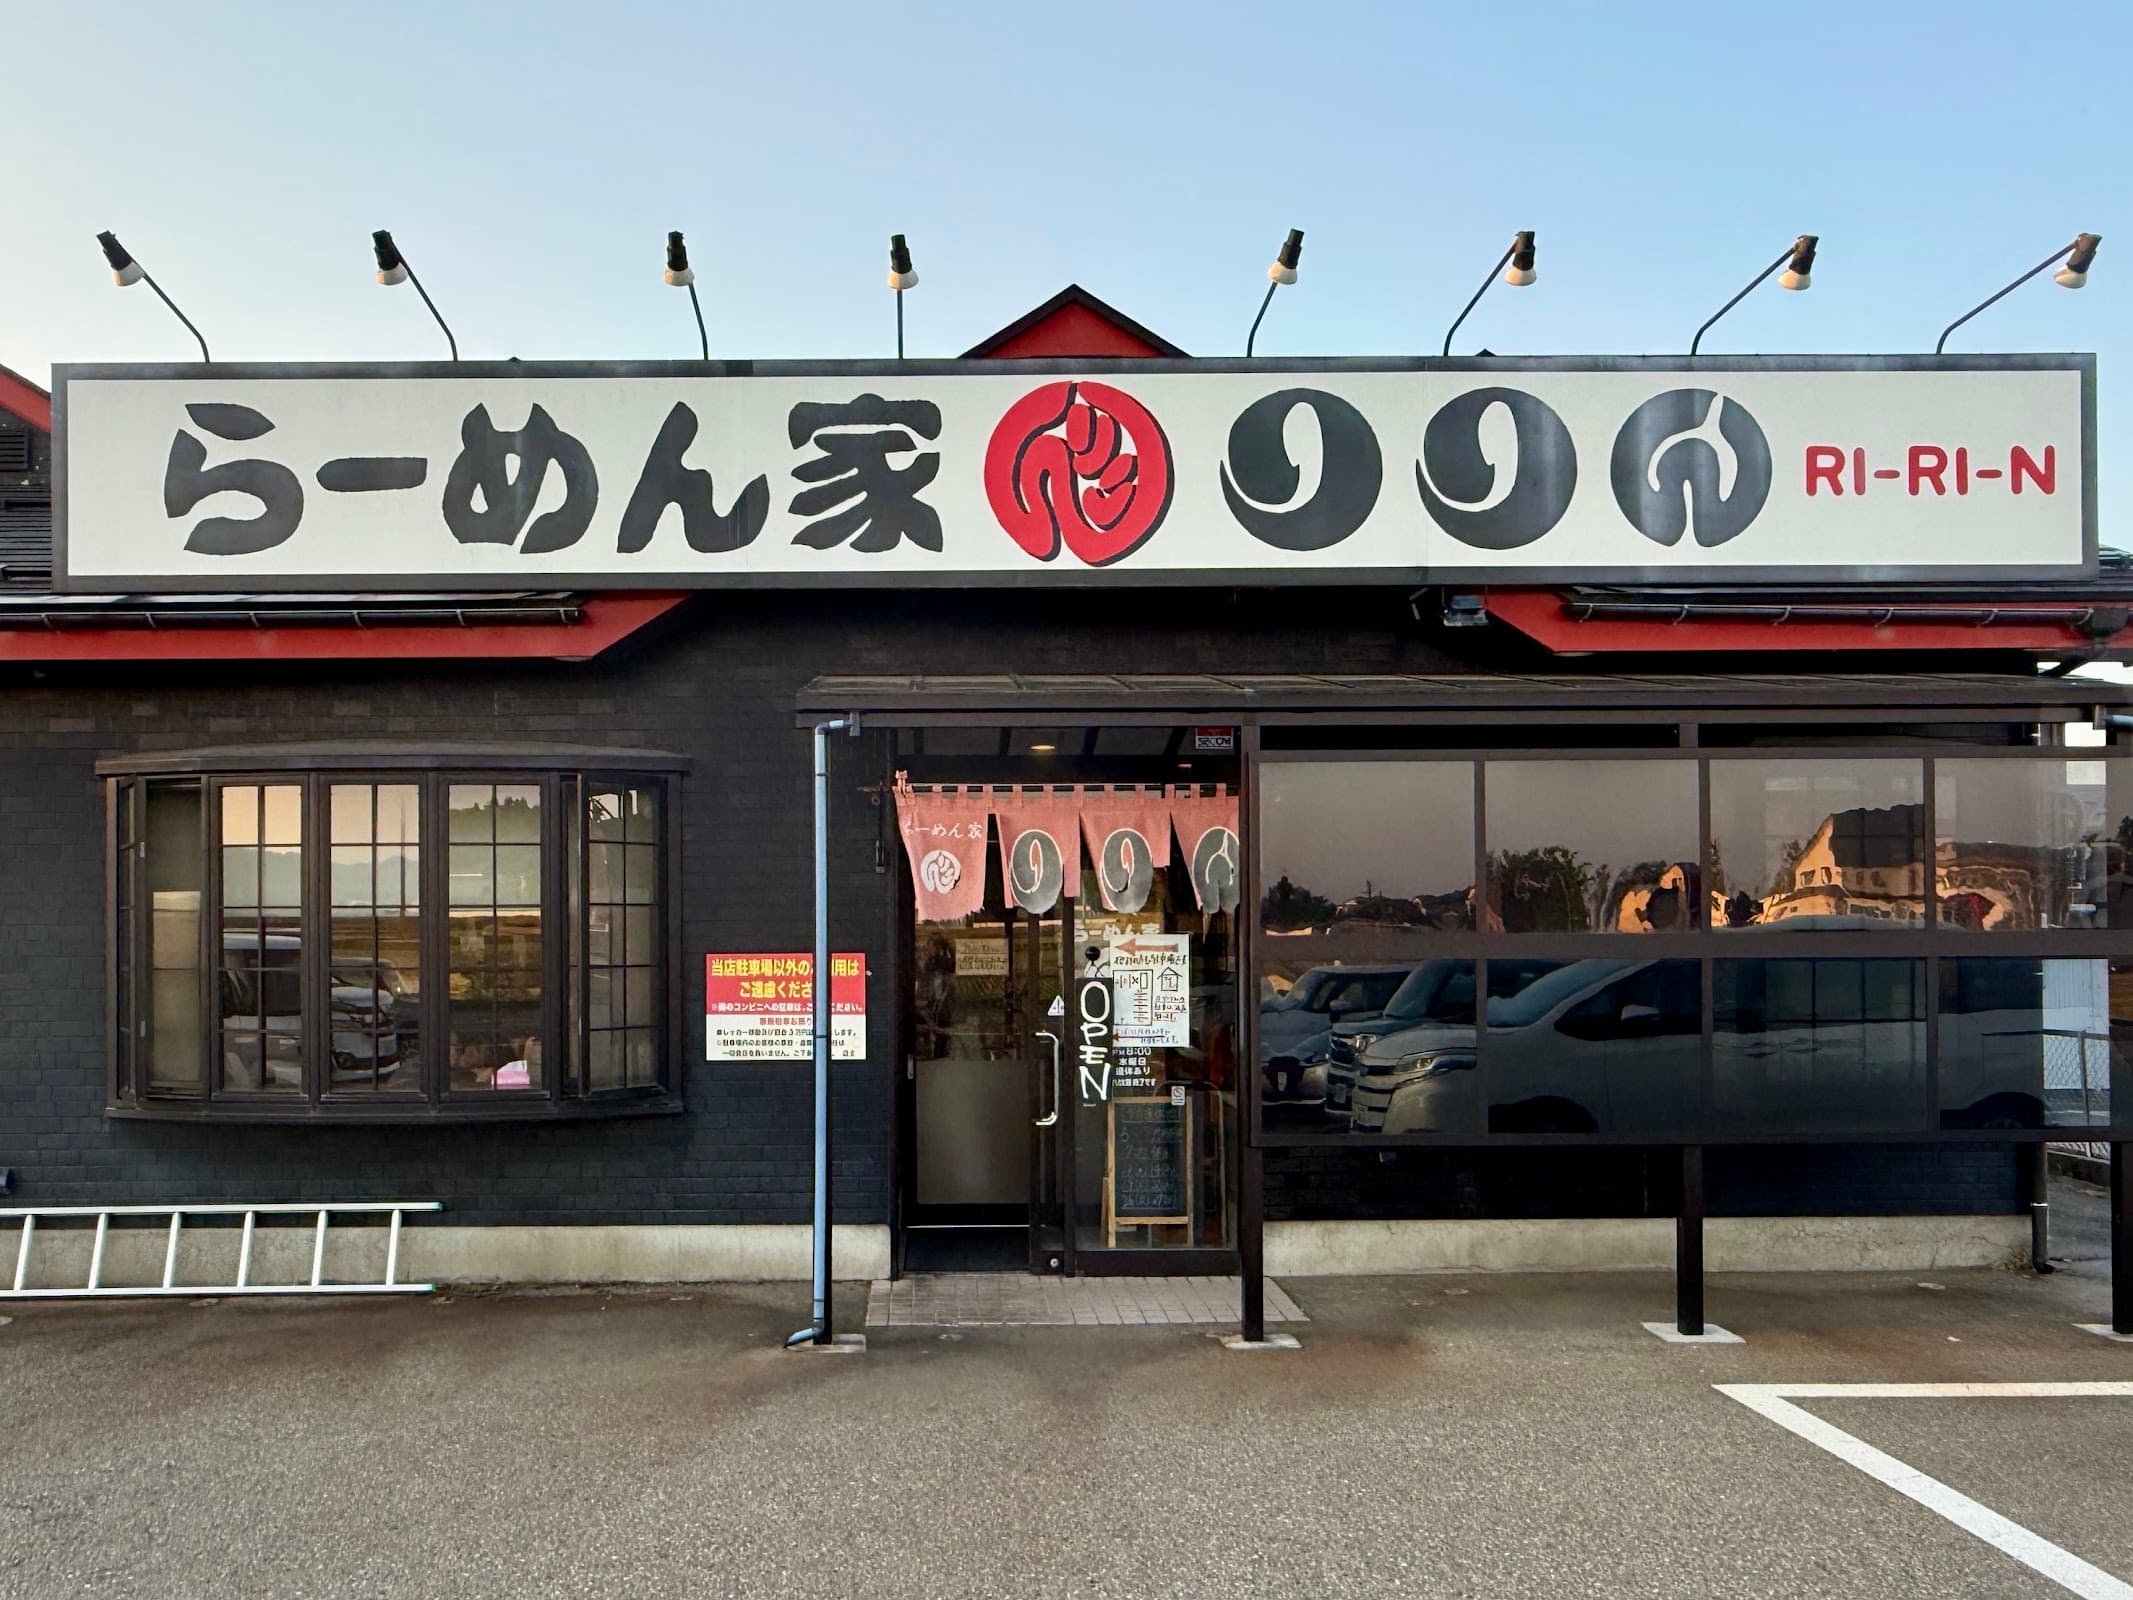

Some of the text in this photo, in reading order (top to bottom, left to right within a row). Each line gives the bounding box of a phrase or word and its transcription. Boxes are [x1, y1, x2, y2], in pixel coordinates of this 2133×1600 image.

[165, 394, 942, 552] らーめん家
[1805, 445, 2055, 496] RI-RI-N
[711, 959, 860, 977] 当店駐車場以外の用は
[1079, 981, 1112, 1100] OPEN
